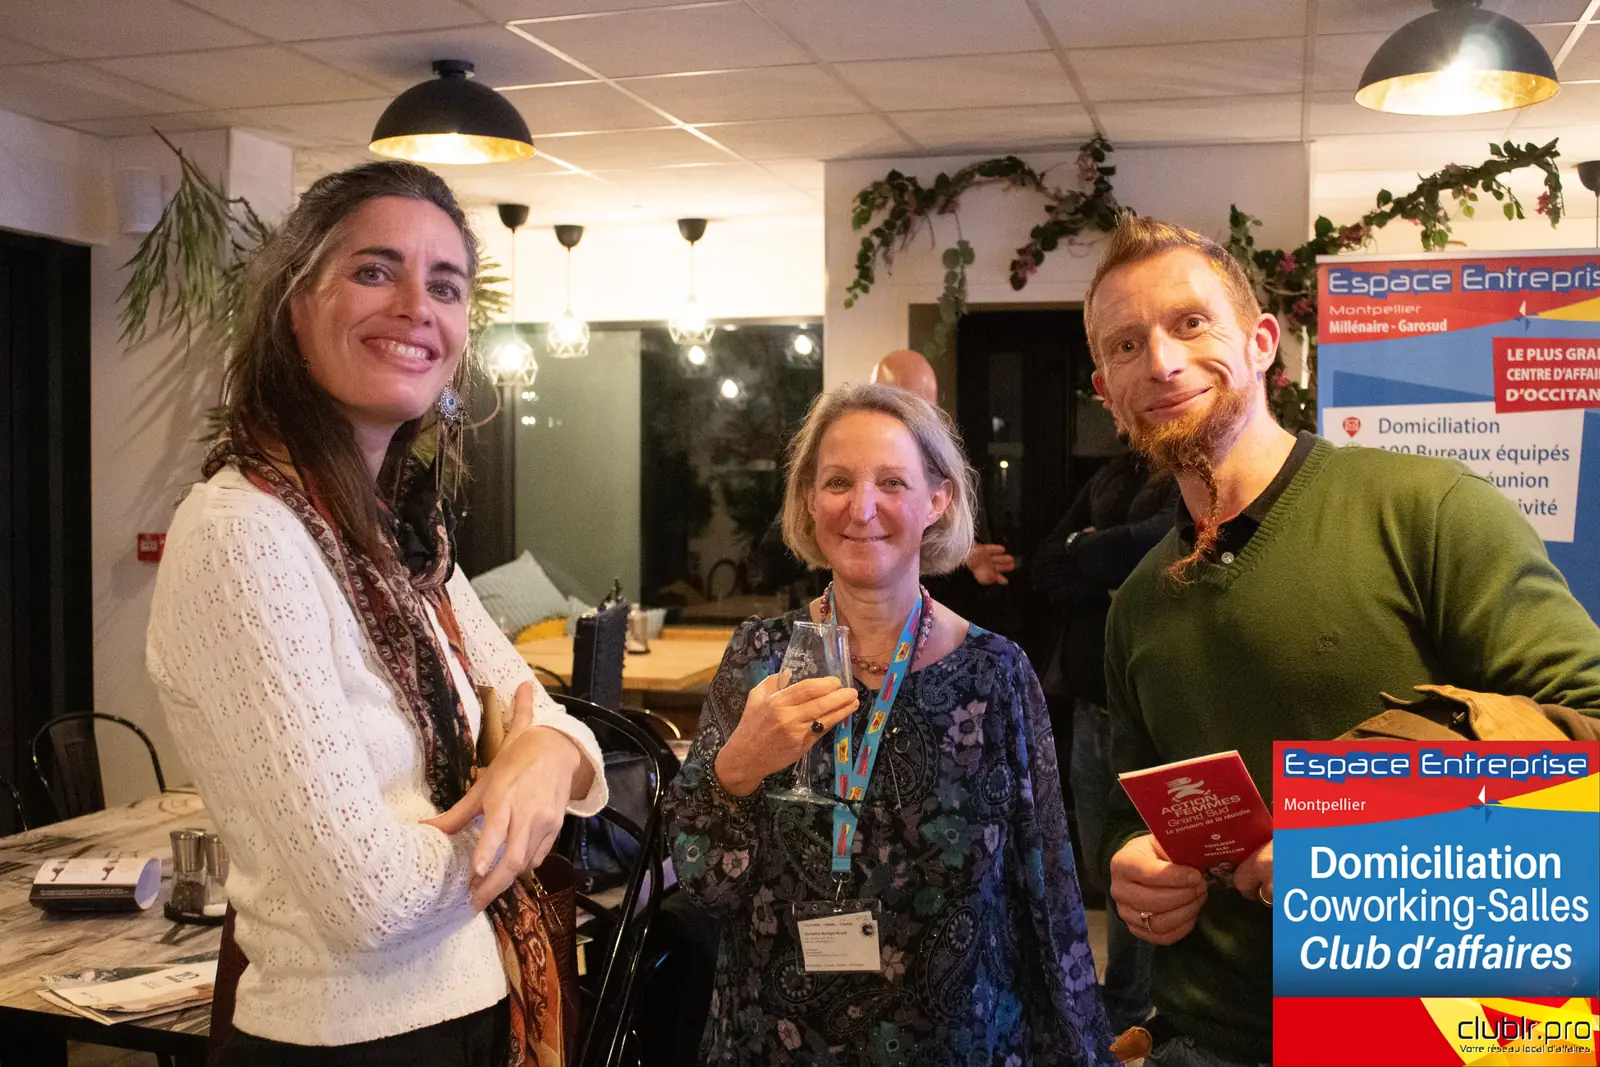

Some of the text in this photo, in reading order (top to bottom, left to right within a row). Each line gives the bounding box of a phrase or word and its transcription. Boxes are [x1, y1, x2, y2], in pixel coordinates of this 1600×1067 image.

[1329, 272, 1451, 296] Espace
[1329, 304, 1422, 316] Montpellier
[1329, 320, 1389, 334] Millénaire
[1398, 319, 1448, 333] Garosud
[1507, 347, 1600, 361] LE PLUS GRA
[1506, 367, 1600, 381] CENTRE D'AFFAI
[1379, 417, 1500, 434] Domiciliation
[1416, 444, 1490, 461] Bureaux
[1496, 444, 1570, 465] équipés
[1161, 794, 1218, 815] ACTION
[1174, 795, 1241, 817] FEMMES
[1167, 806, 1229, 827] Grand Sud
[1175, 822, 1204, 833] parcours
[1223, 809, 1251, 820] réussite
